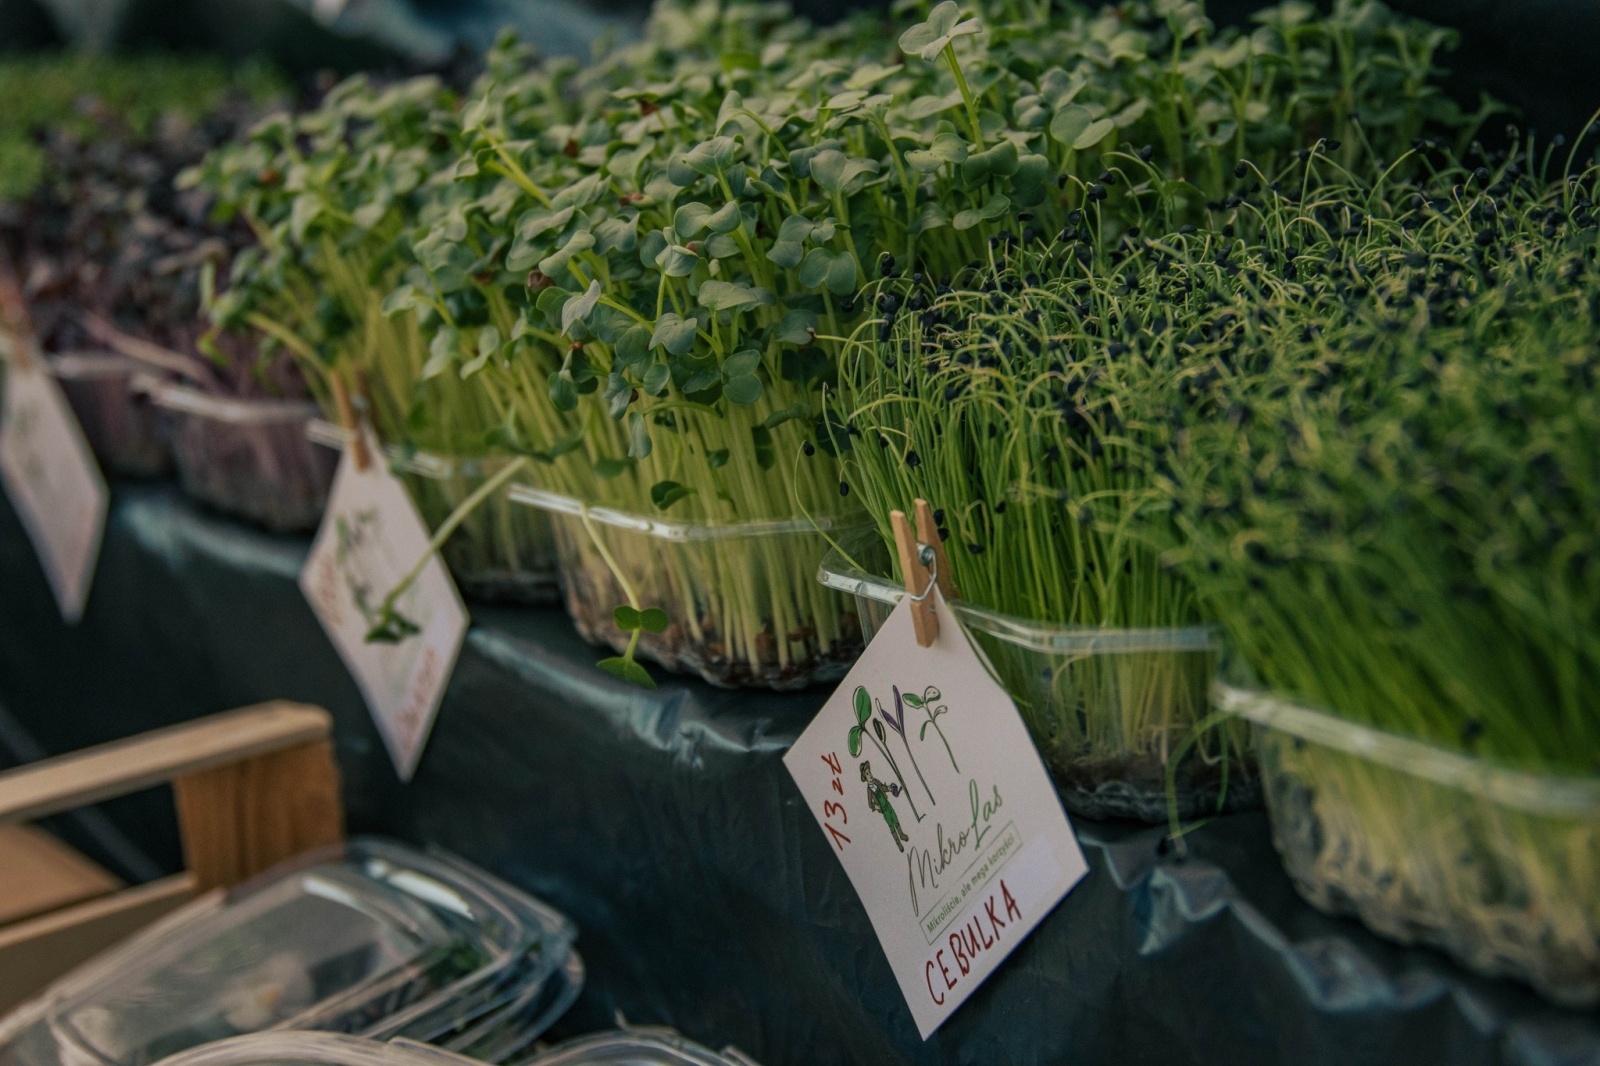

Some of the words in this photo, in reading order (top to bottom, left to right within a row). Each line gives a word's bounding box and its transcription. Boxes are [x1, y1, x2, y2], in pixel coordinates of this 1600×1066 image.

[821, 751, 842, 795] zł
[824, 799, 851, 851] 13
[960, 882, 972, 898] ale
[970, 862, 989, 886] mega
[925, 878, 1022, 1006] CEBULKA
